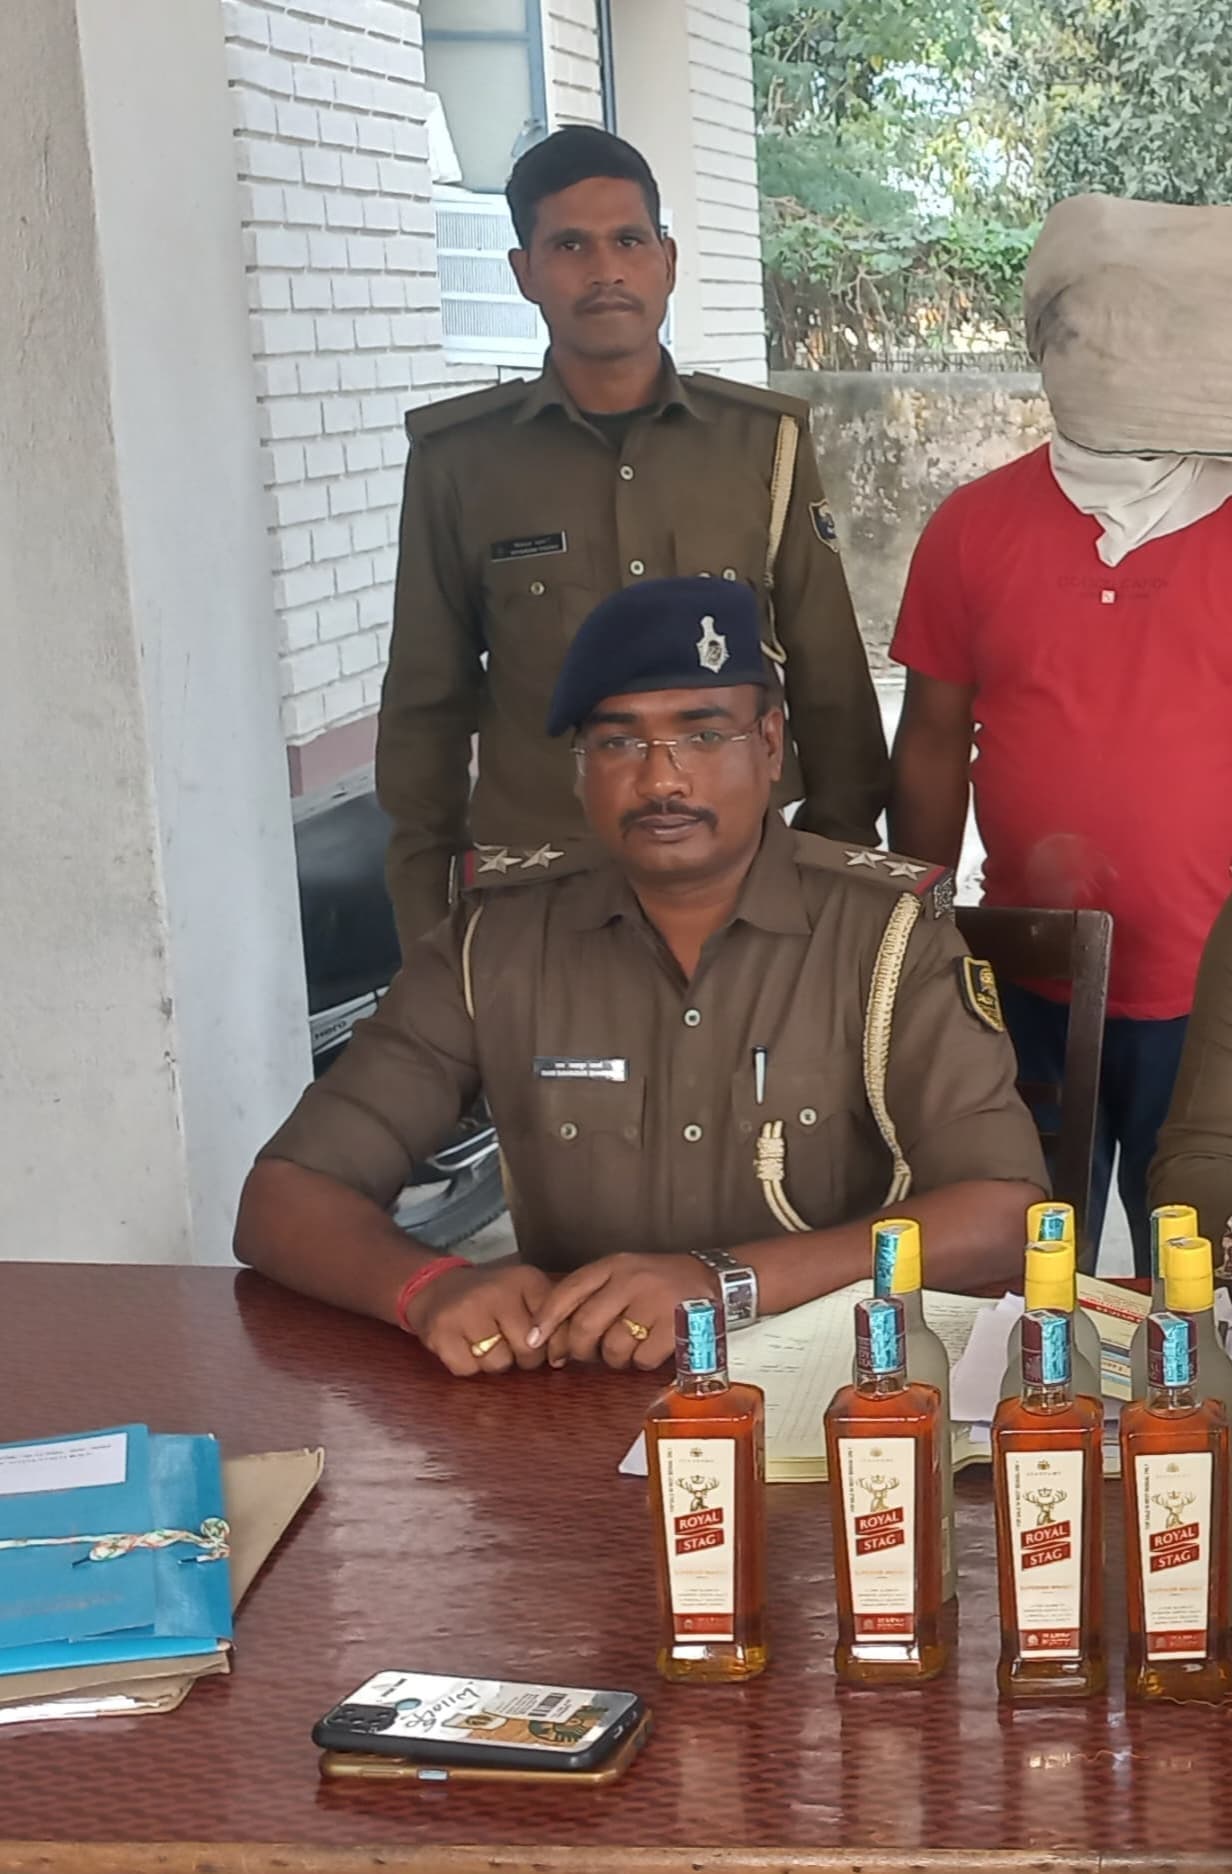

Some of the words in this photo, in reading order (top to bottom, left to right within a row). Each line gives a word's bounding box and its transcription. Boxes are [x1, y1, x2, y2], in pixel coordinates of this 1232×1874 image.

[680, 1511, 720, 1530] ROYAL
[860, 1511, 899, 1530] ROYAL
[683, 1534, 716, 1550] STAG
[863, 1534, 896, 1550] STAG
[1025, 1525, 1067, 1545] ROYAL
[1154, 1527, 1195, 1547] ROYAL
[1030, 1548, 1062, 1566] STAG
[1158, 1550, 1191, 1568] STAG
